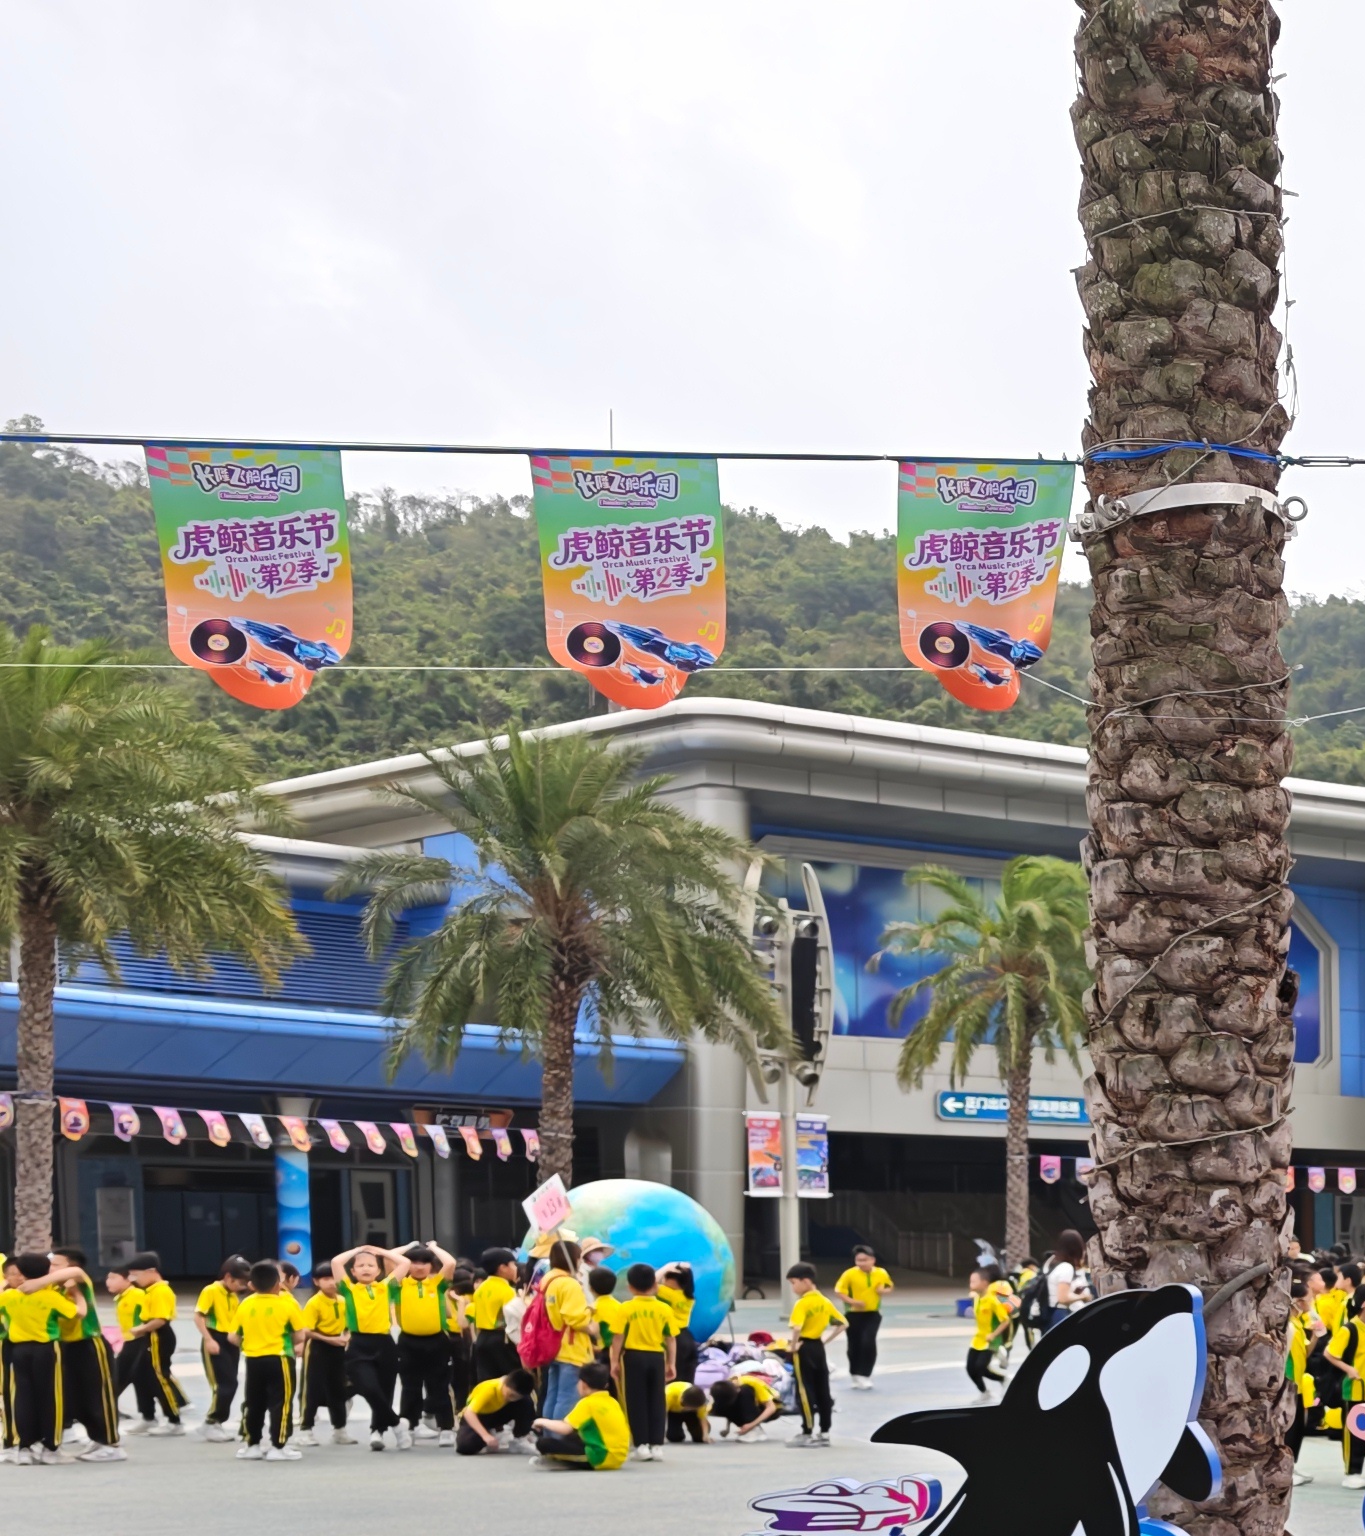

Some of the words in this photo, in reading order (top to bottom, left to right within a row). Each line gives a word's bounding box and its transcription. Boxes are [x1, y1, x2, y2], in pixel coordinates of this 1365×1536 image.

[194, 464, 298, 490] 长隆飞船乐园
[576, 473, 676, 498] 长隆飞船乐园
[939, 479, 1035, 503] 长隆飞船乐园
[174, 513, 335, 559] 虎鲸音乐节
[554, 519, 711, 565] 虎鲸音乐节
[909, 522, 1061, 566] 虎鲸音乐节
[251, 554, 276, 562] Music
[279, 550, 315, 559] Festival
[626, 559, 651, 567] Music
[654, 555, 690, 564] Festival
[979, 562, 1005, 570] Music
[1007, 557, 1035, 568] Festival
[252, 558, 321, 594] 第2季
[627, 562, 695, 598] 第2季
[979, 565, 1038, 601] 第2季
